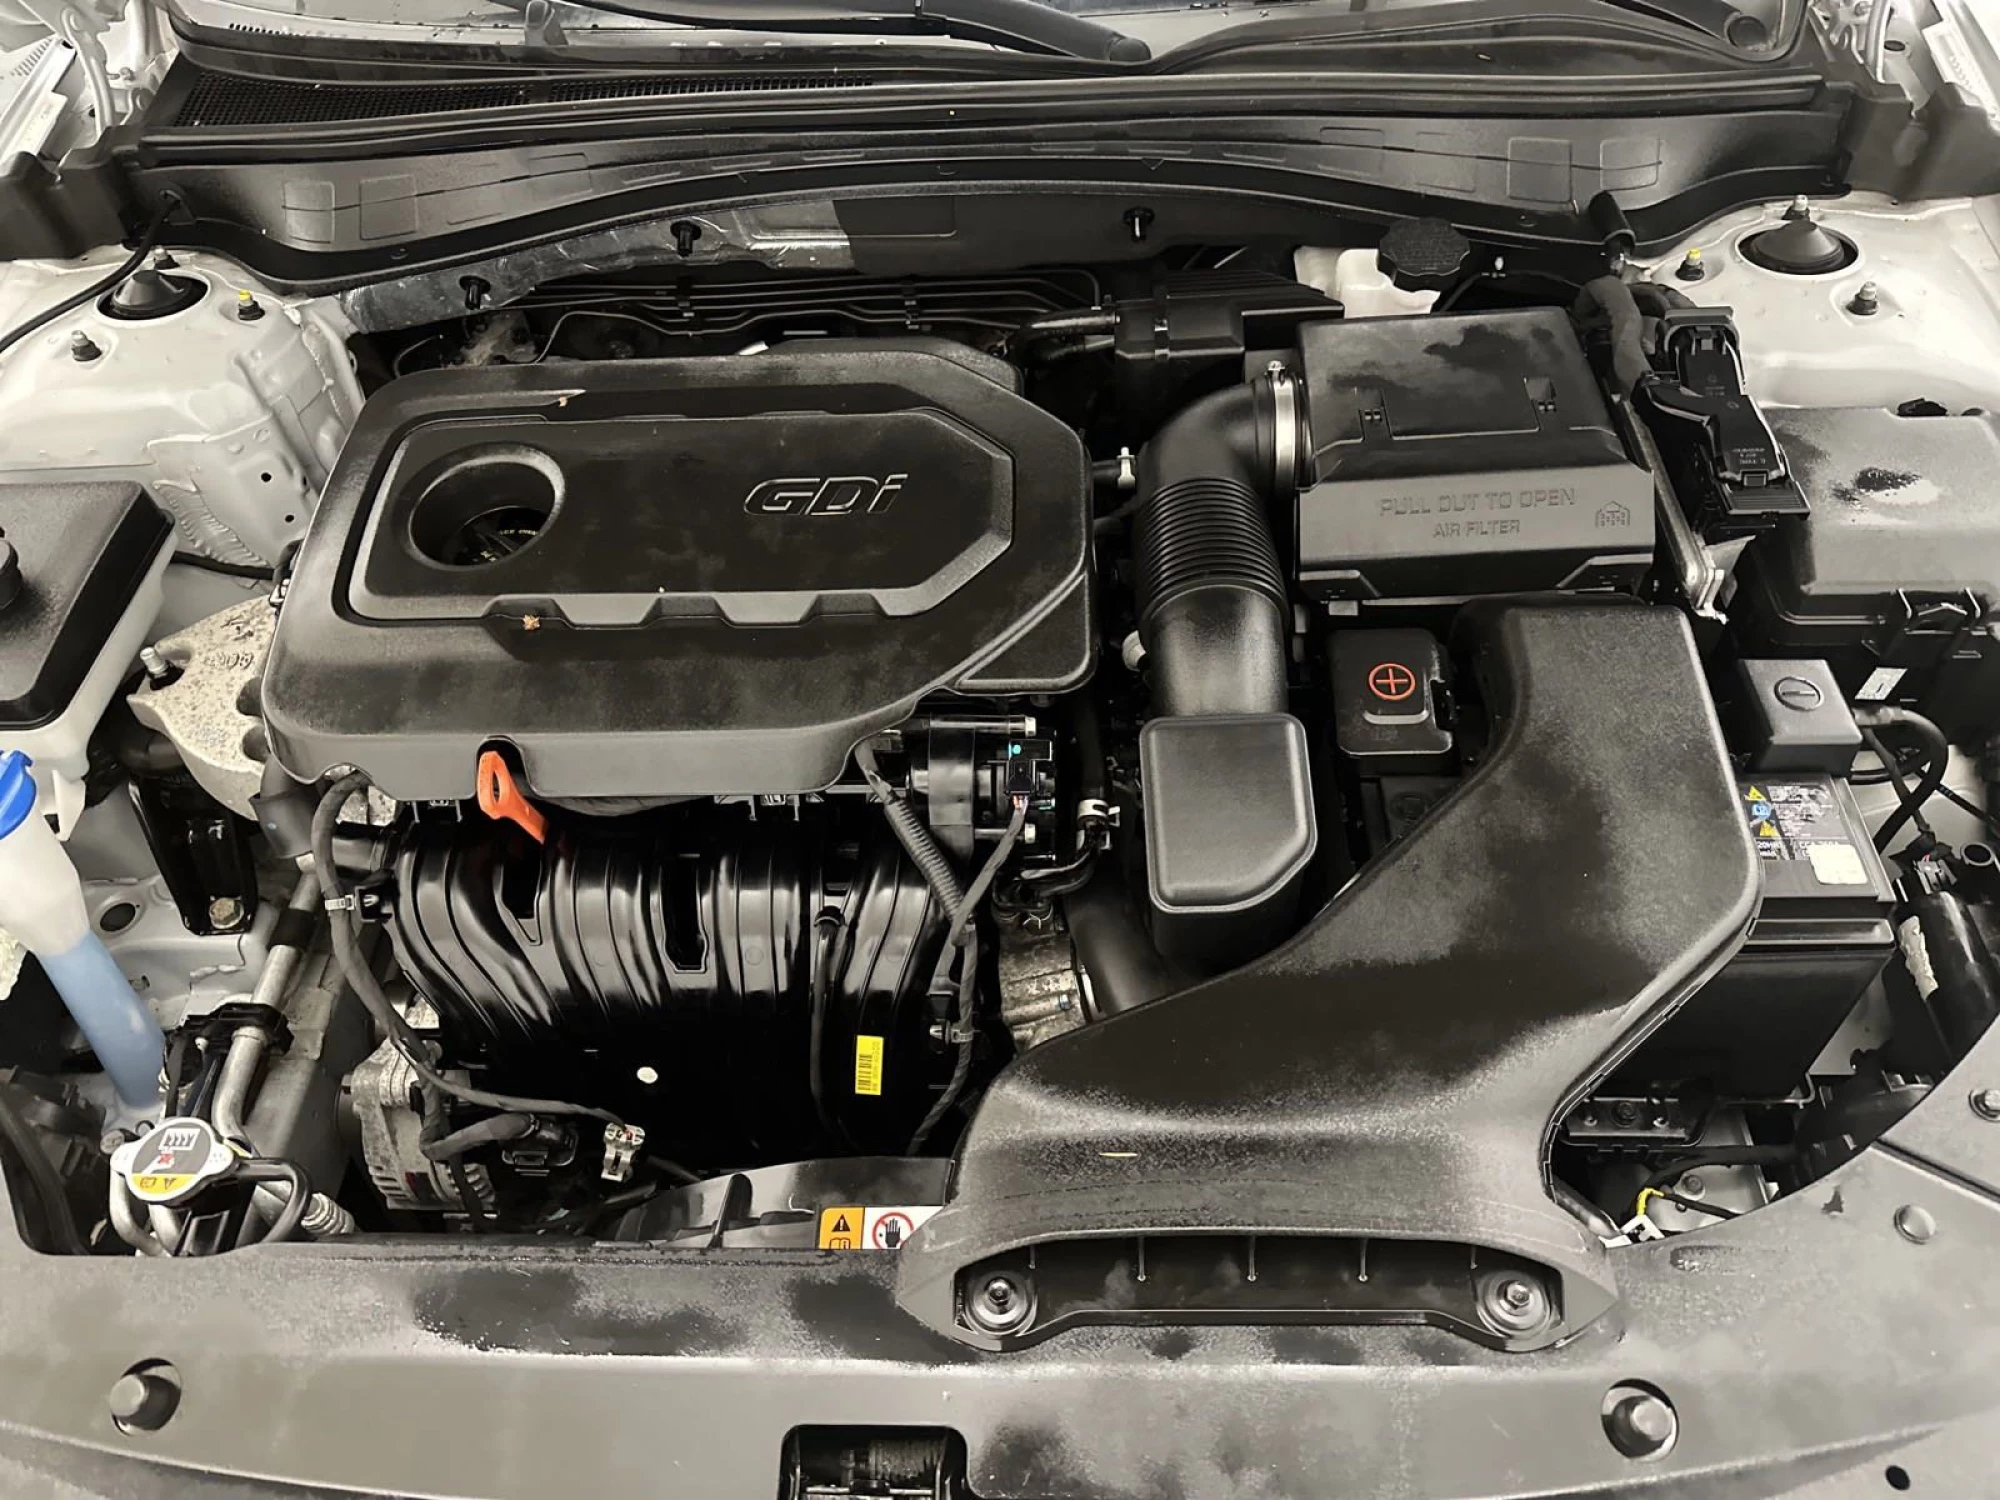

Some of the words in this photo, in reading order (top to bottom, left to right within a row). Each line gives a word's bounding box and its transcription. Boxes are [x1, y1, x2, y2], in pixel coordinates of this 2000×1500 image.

[743, 473, 908, 516] GDi
[1379, 498, 1431, 516] PULL
[1437, 494, 1481, 513] OUT
[1484, 491, 1511, 510] TO
[1519, 488, 1576, 508] OPEN
[1432, 521, 1461, 538] AIR
[1465, 519, 1521, 537] FILTER
